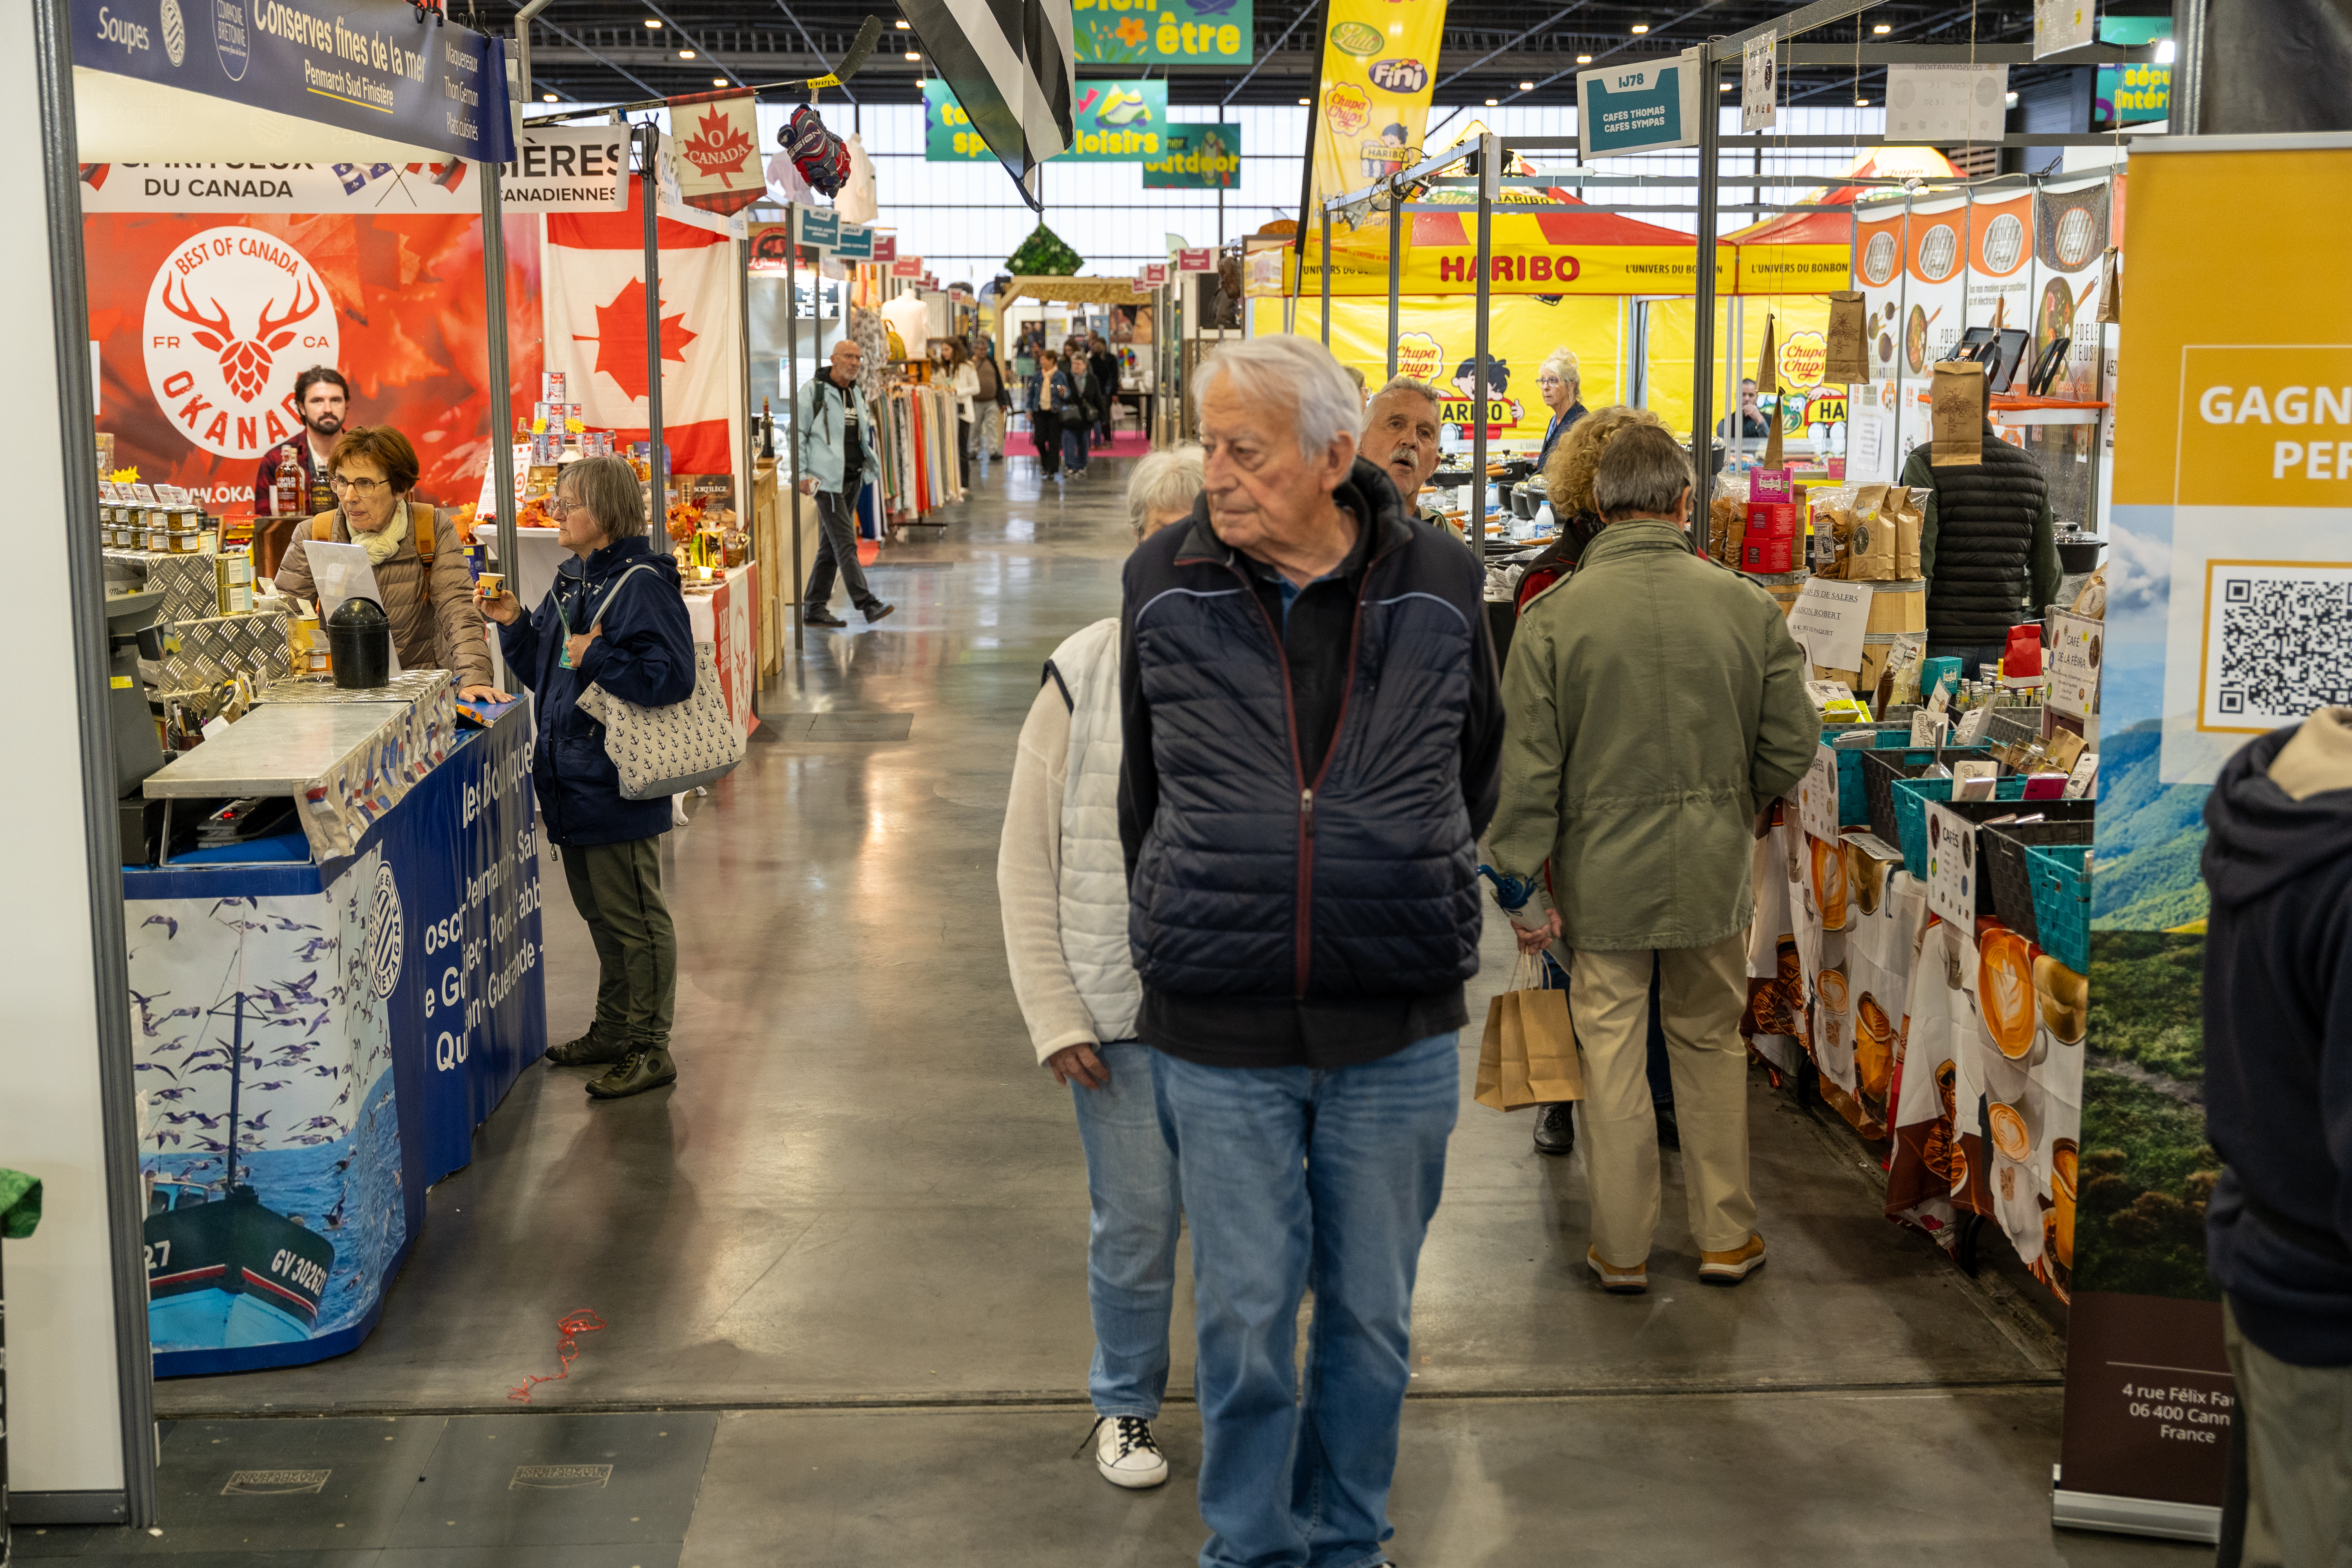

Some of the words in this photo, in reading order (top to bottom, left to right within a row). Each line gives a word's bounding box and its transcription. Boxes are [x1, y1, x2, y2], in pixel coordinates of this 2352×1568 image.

[97, 6, 149, 54] Soupes
[218, 20, 246, 47] BRETONNE
[1156, 12, 1240, 54] être
[254, 0, 332, 54] Conserves
[336, 16, 368, 65] fines
[372, 31, 388, 71] de
[390, 36, 403, 76] la
[405, 50, 426, 83] mer
[446, 41, 478, 73] Maquereaux
[305, 59, 345, 94] Penmarch
[347, 72, 361, 98] Sud
[363, 76, 393, 107] Finistère
[1374, 64, 1423, 91] Fini
[1619, 74, 1644, 88] IJ78
[2125, 64, 2171, 87] sécu
[445, 76, 459, 100] Thon
[460, 82, 478, 107] Germon
[2114, 85, 2169, 109] intéri
[1333, 93, 1366, 112] Chupa
[1328, 105, 1362, 123] Chups
[1603, 111, 1628, 122] CAFES
[1630, 105, 1665, 117] THOMAS
[446, 112, 458, 135] Plats
[459, 118, 478, 141] cuisinés
[1604, 122, 1630, 133] CAFES
[1632, 117, 1665, 129] SYMPAS
[708, 130, 724, 148] O
[1076, 130, 1158, 154] loisirs
[689, 144, 749, 164] CANADA
[1368, 148, 1405, 159] HARIBO
[145, 179, 180, 196] DU
[189, 179, 293, 197] CANADA
[500, 188, 617, 201] ANADIENNES
[1989, 225, 2019, 243] RADIGUE
[2061, 218, 2089, 235] RADIGUE
[175, 243, 209, 275] BEST
[213, 238, 232, 256] OF
[239, 238, 299, 276] CANADA
[1626, 264, 1670, 274] L'UNIVERS
[1672, 265, 1684, 274] DU
[1752, 263, 1794, 274] L'UNIVERS
[1797, 264, 1809, 273] DU
[1812, 262, 1847, 272] BONBON
[153, 336, 180, 348] FR
[303, 336, 329, 348] CA
[2106, 359, 2117, 377] 452
[163, 370, 306, 450] OKANAD
[1831, 592, 1858, 602] SALERS
[1814, 609, 1842, 619] ROBERT
[2067, 635, 2080, 647] CAFÉ
[2058, 652, 2064, 662] DE
[1810, 756, 1824, 772] AFÉS
[463, 782, 480, 829] les
[1943, 827, 1958, 848] CAFÉS
[374, 902, 400, 991] BRETAGNE
[272, 1249, 297, 1277] GV
[2122, 1383, 2134, 1397] 4
[2137, 1386, 2166, 1401] rue
[2169, 1387, 2207, 1405] Félix
[2129, 1402, 2151, 1417] 06
[2152, 1405, 2183, 1421] 400
[2187, 1408, 2231, 1426] Cann
[2160, 1424, 2216, 1444] France
